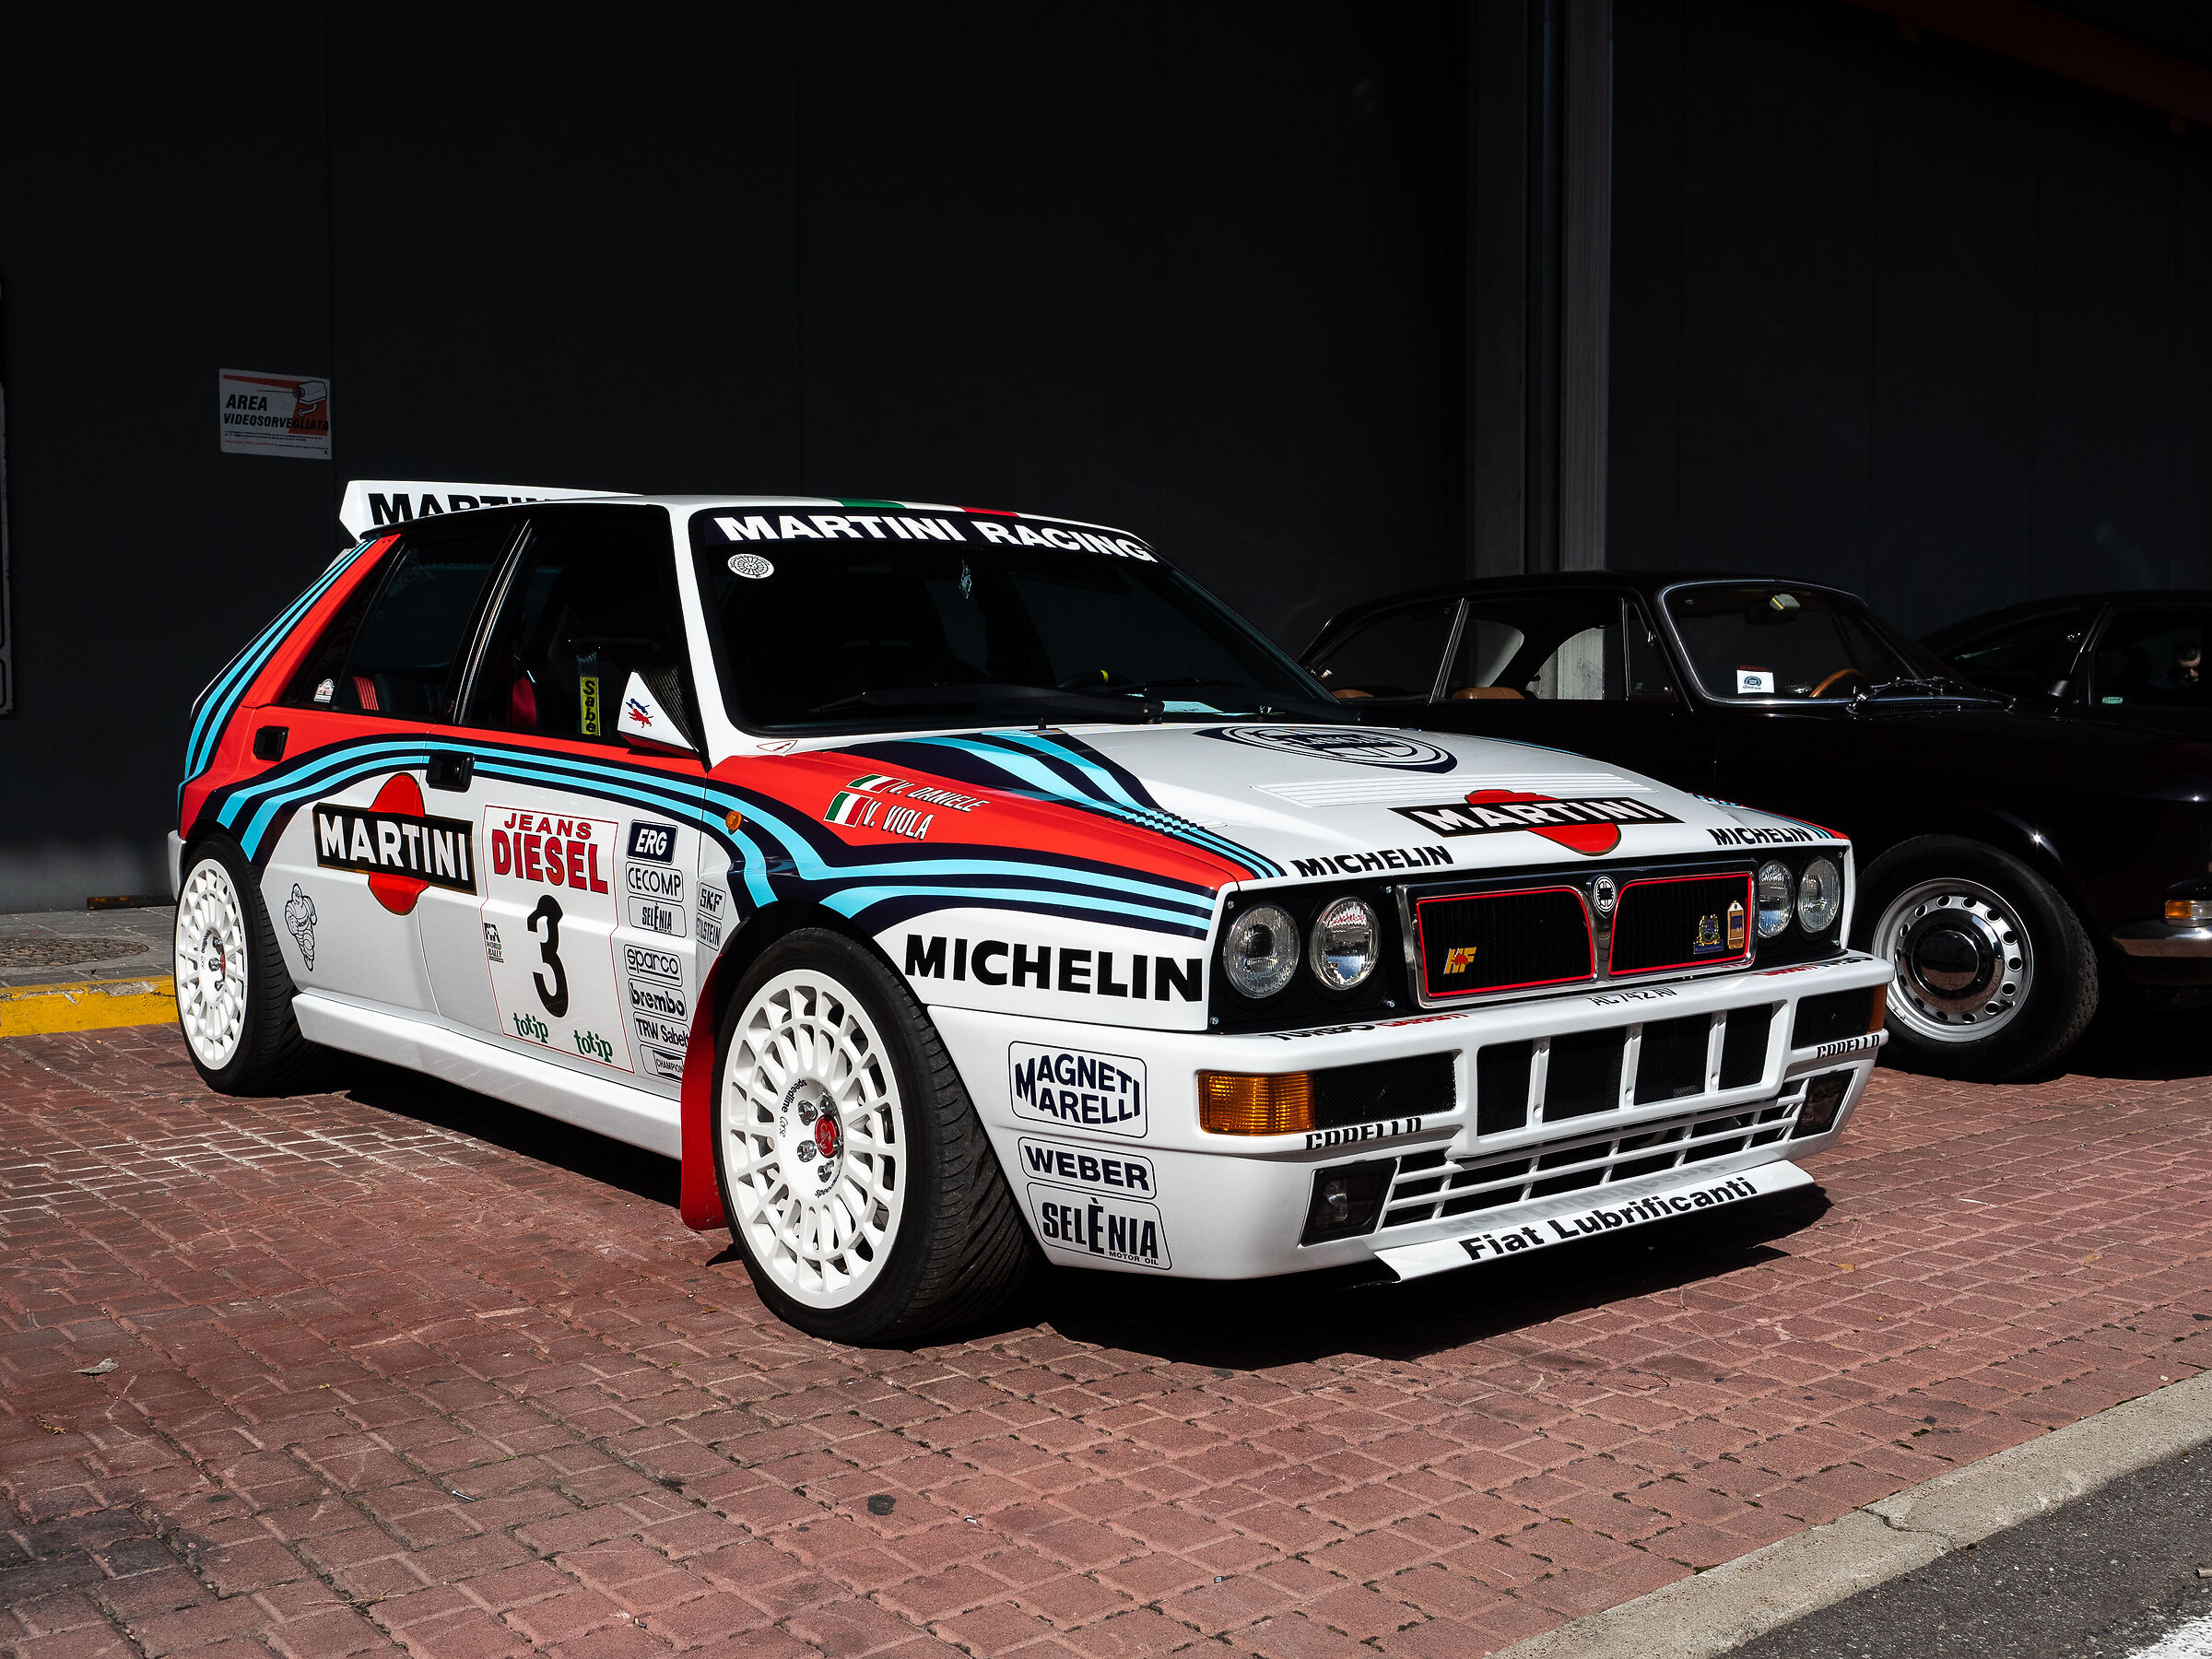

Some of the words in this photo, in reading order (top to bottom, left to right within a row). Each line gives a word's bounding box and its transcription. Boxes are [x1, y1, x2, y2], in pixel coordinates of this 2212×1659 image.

[226, 394, 267, 411] AREA
[224, 413, 329, 431] VIDEOSORVEGLIATA
[713, 515, 966, 541] MARTINI
[971, 521, 1159, 562] RACING
[887, 782, 915, 794] V.
[907, 786, 990, 812] DANIELE
[504, 813, 592, 840] JEANS
[862, 801, 883, 828] V.
[881, 805, 935, 840] VIOLA
[1411, 800, 1665, 830] MARTINI
[319, 813, 468, 881] MARTINI
[635, 828, 668, 855] ERG
[1706, 828, 1814, 846] MICHELIN
[492, 829, 608, 895] DIESEL
[1289, 845, 1454, 877] MICHELIN
[628, 867, 681, 896] CECOMP
[700, 888, 723, 912] SKF
[488, 947, 502, 958] RALLY
[527, 894, 570, 1018] 3
[627, 947, 678, 975] sparco
[904, 934, 1204, 1003] MICHELIN
[630, 982, 685, 1017] brembo
[513, 1013, 549, 1044] totip
[636, 1018, 659, 1041] TRW
[573, 1030, 613, 1063] totip
[782, 1078, 807, 1113] speedline
[1015, 1053, 1140, 1111] MAGNETI
[1024, 1146, 1150, 1192] WEBER
[1458, 1225, 1546, 1261] Fiat
[1547, 1176, 1758, 1240] Lubrificanti
[1109, 1251, 1140, 1264] MOTOR
[1144, 1257, 1159, 1266] OIL
